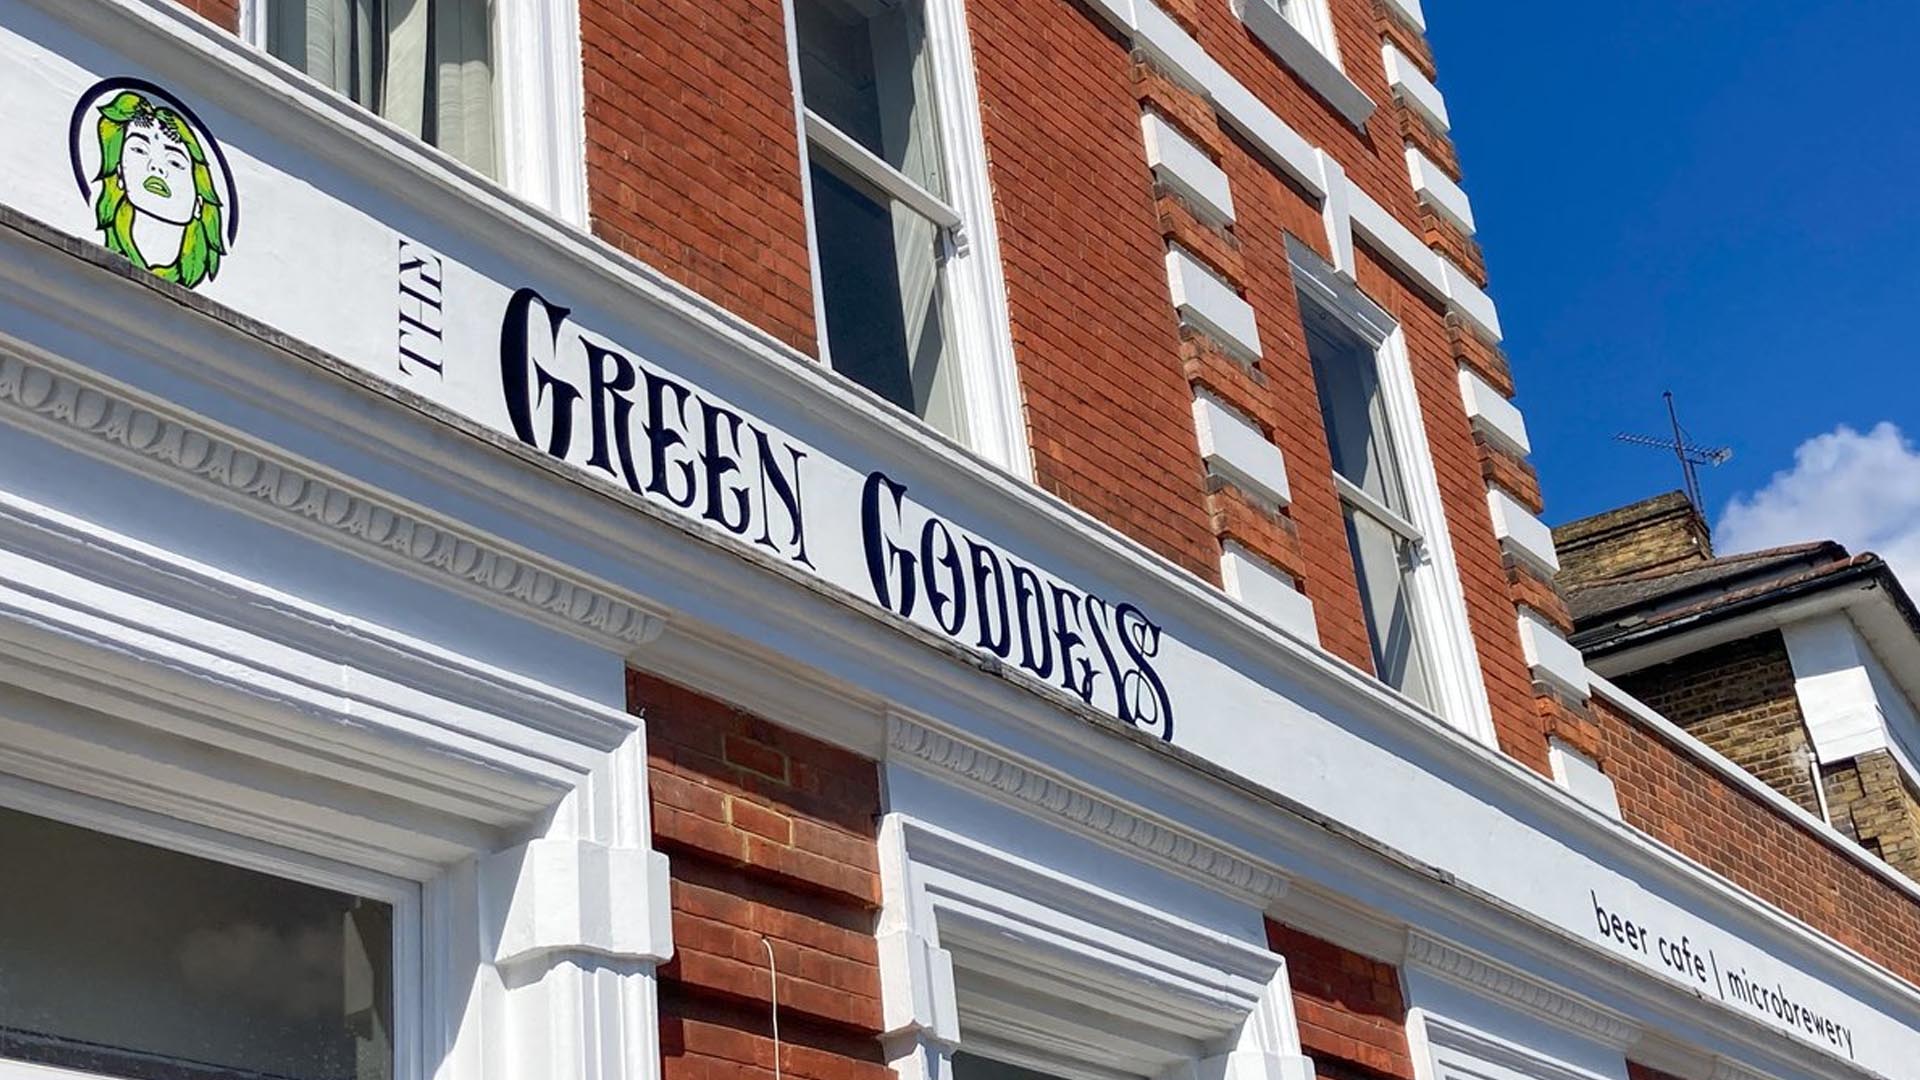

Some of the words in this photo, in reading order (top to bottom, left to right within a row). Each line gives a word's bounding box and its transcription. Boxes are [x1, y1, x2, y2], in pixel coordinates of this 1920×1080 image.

[399, 239, 443, 380] THE
[500, 287, 816, 571] GREEN
[861, 471, 1173, 743] GODDESS
[1591, 889, 1648, 954] beer
[1659, 936, 1706, 983] cafe
[1727, 968, 1854, 1059] microbrewery
